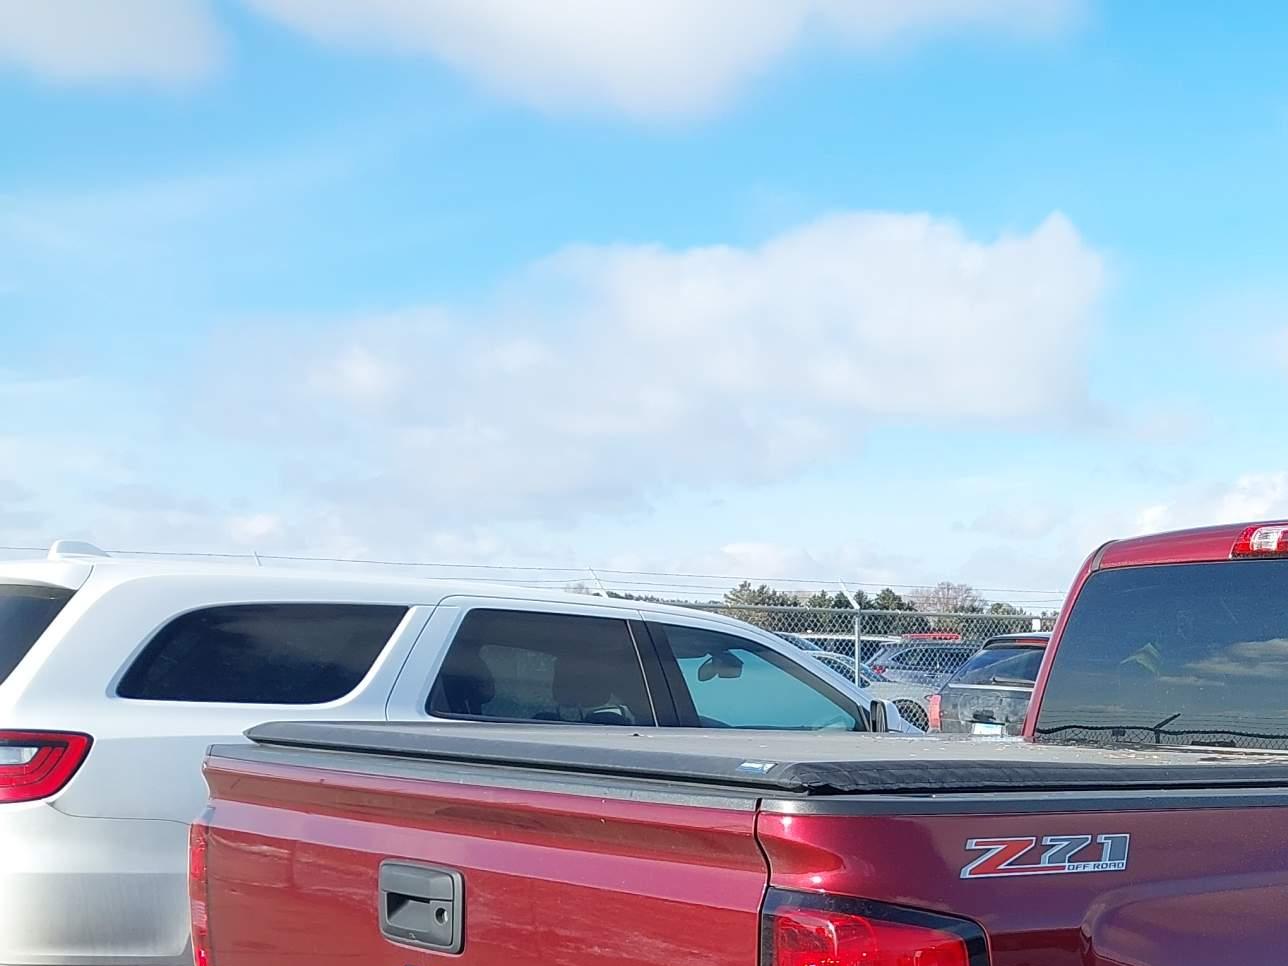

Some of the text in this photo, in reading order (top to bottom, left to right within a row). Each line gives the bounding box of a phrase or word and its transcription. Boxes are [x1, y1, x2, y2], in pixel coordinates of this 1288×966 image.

[959, 833, 1130, 878] Z71
[1067, 861, 1125, 871] OFF ROAD
